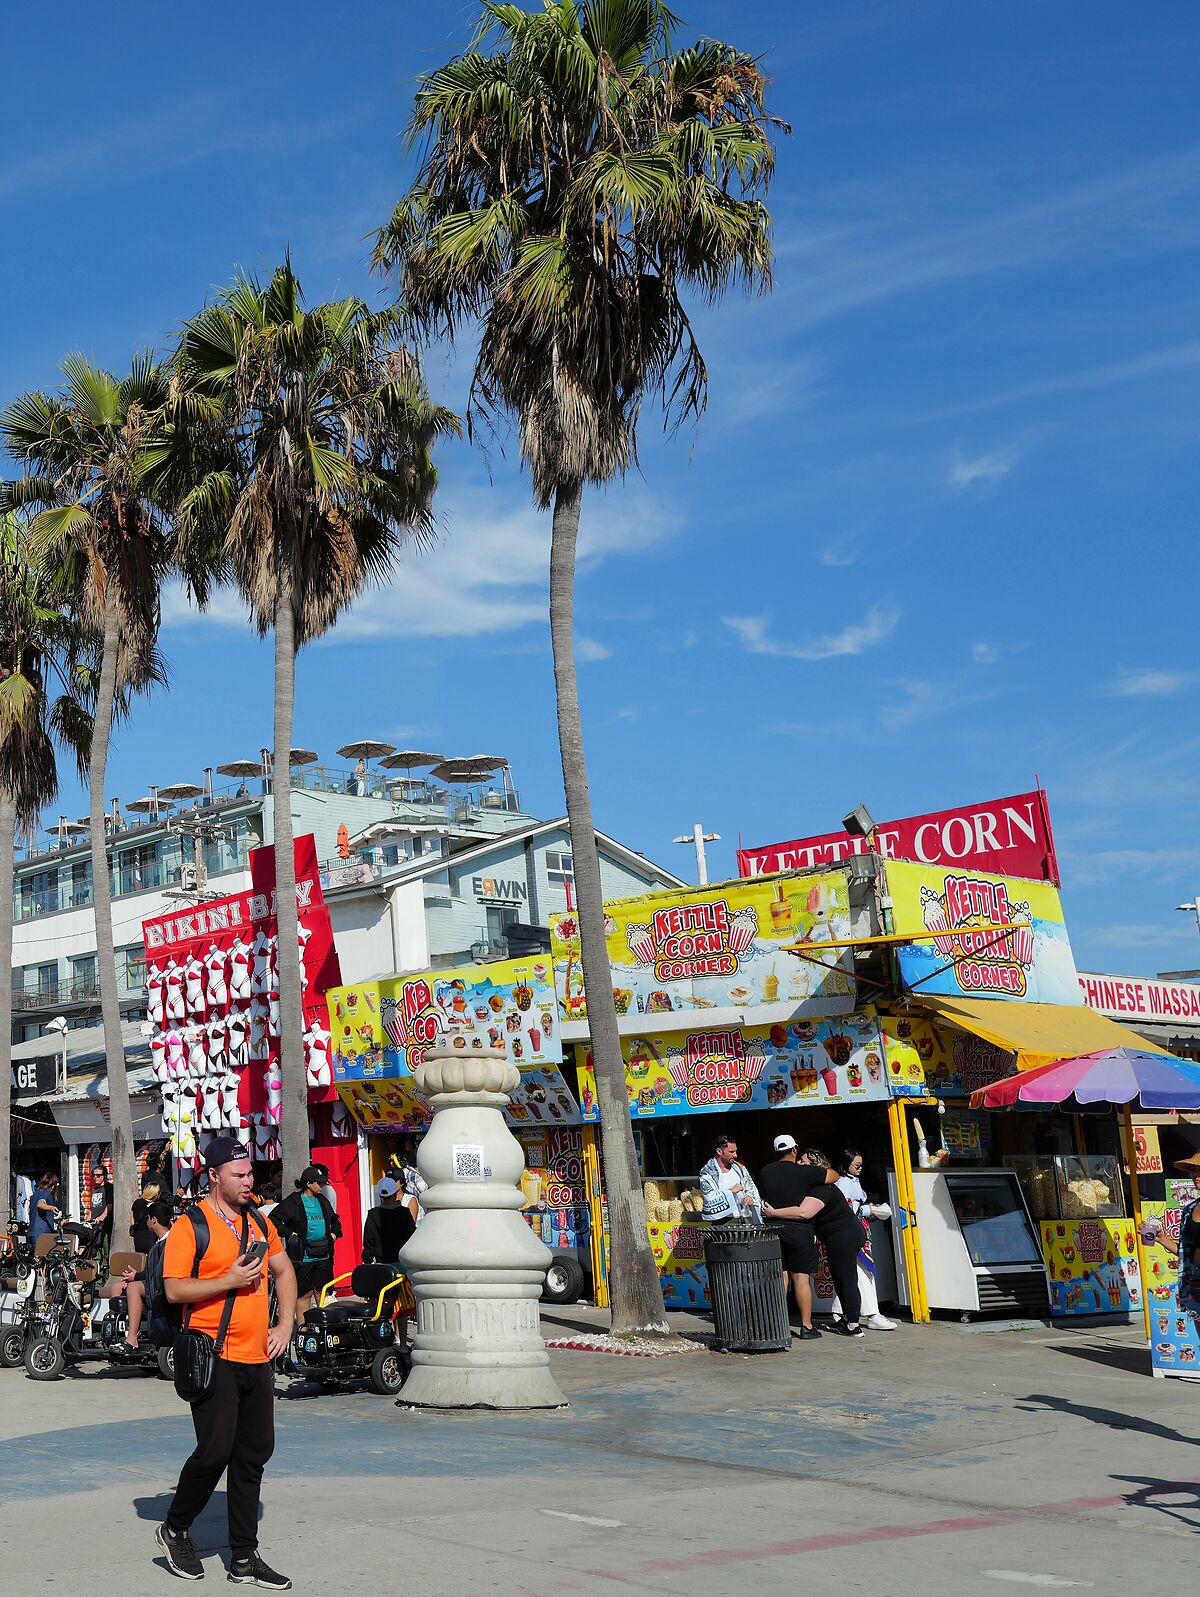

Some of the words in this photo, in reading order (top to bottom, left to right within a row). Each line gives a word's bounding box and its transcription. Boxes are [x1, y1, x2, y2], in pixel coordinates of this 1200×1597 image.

[914, 802, 1038, 864] CORN
[146, 901, 243, 949] BIKINI
[247, 880, 314, 921] BY
[945, 877, 1010, 927] KETTLE
[654, 901, 729, 945] KETTLE
[664, 932, 724, 960] CORN
[958, 922, 1010, 960] CORN
[659, 955, 732, 979] CORNER
[958, 961, 1023, 992] CORNER
[1148, 986, 1200, 1017] MASSA
[687, 1030, 744, 1066] KETTLE
[695, 1058, 739, 1083] CORN
[690, 1083, 748, 1103] CORNER
